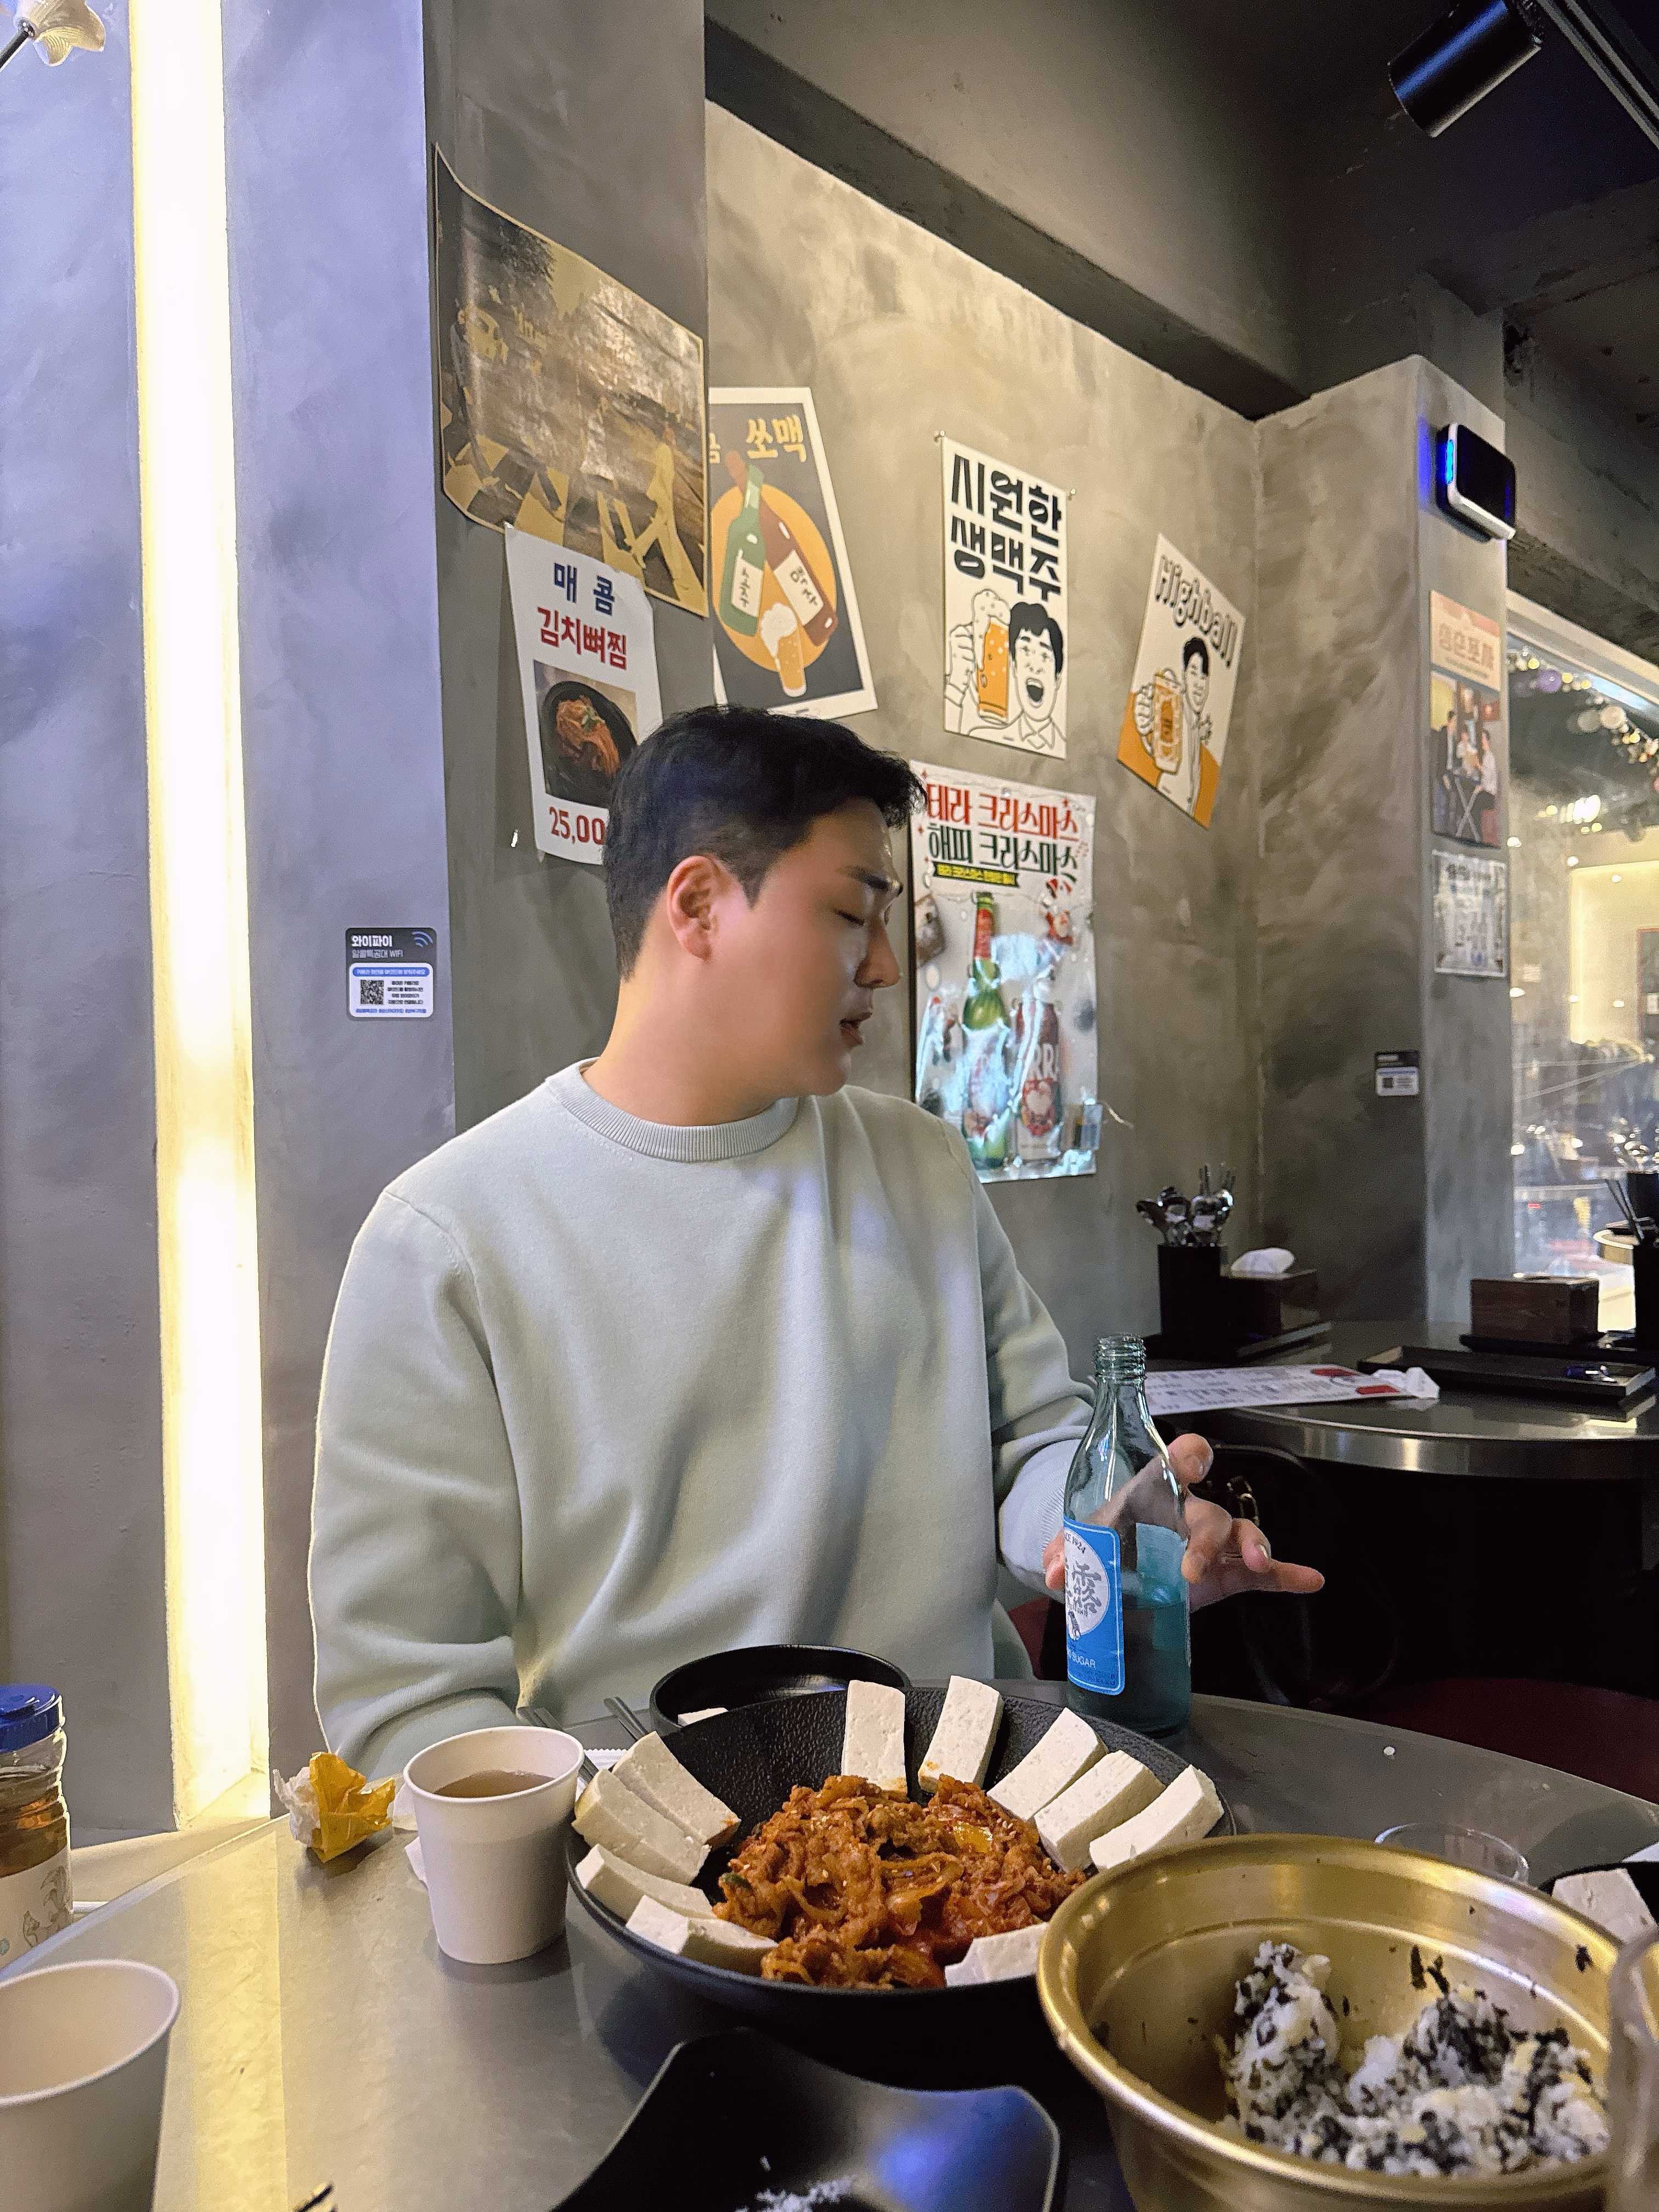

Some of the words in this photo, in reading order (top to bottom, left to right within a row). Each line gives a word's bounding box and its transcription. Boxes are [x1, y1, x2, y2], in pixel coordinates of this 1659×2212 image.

[952, 453, 1062, 549] 시원한
[951, 515, 1062, 602] 생맥주
[537, 606, 627, 670] 김치뼈찜
[1154, 555, 1238, 669] Highball
[549, 806, 606, 845] 25,00
[926, 783, 973, 825] 테라
[979, 792, 1079, 842] 크리스마스
[927, 823, 973, 864] 해피
[979, 832, 1077, 882] 크리스마스
[351, 935, 393, 947] 와이파이
[1072, 1536, 1086, 1554] 1924
[1071, 1651, 1096, 1669] SUGAR
